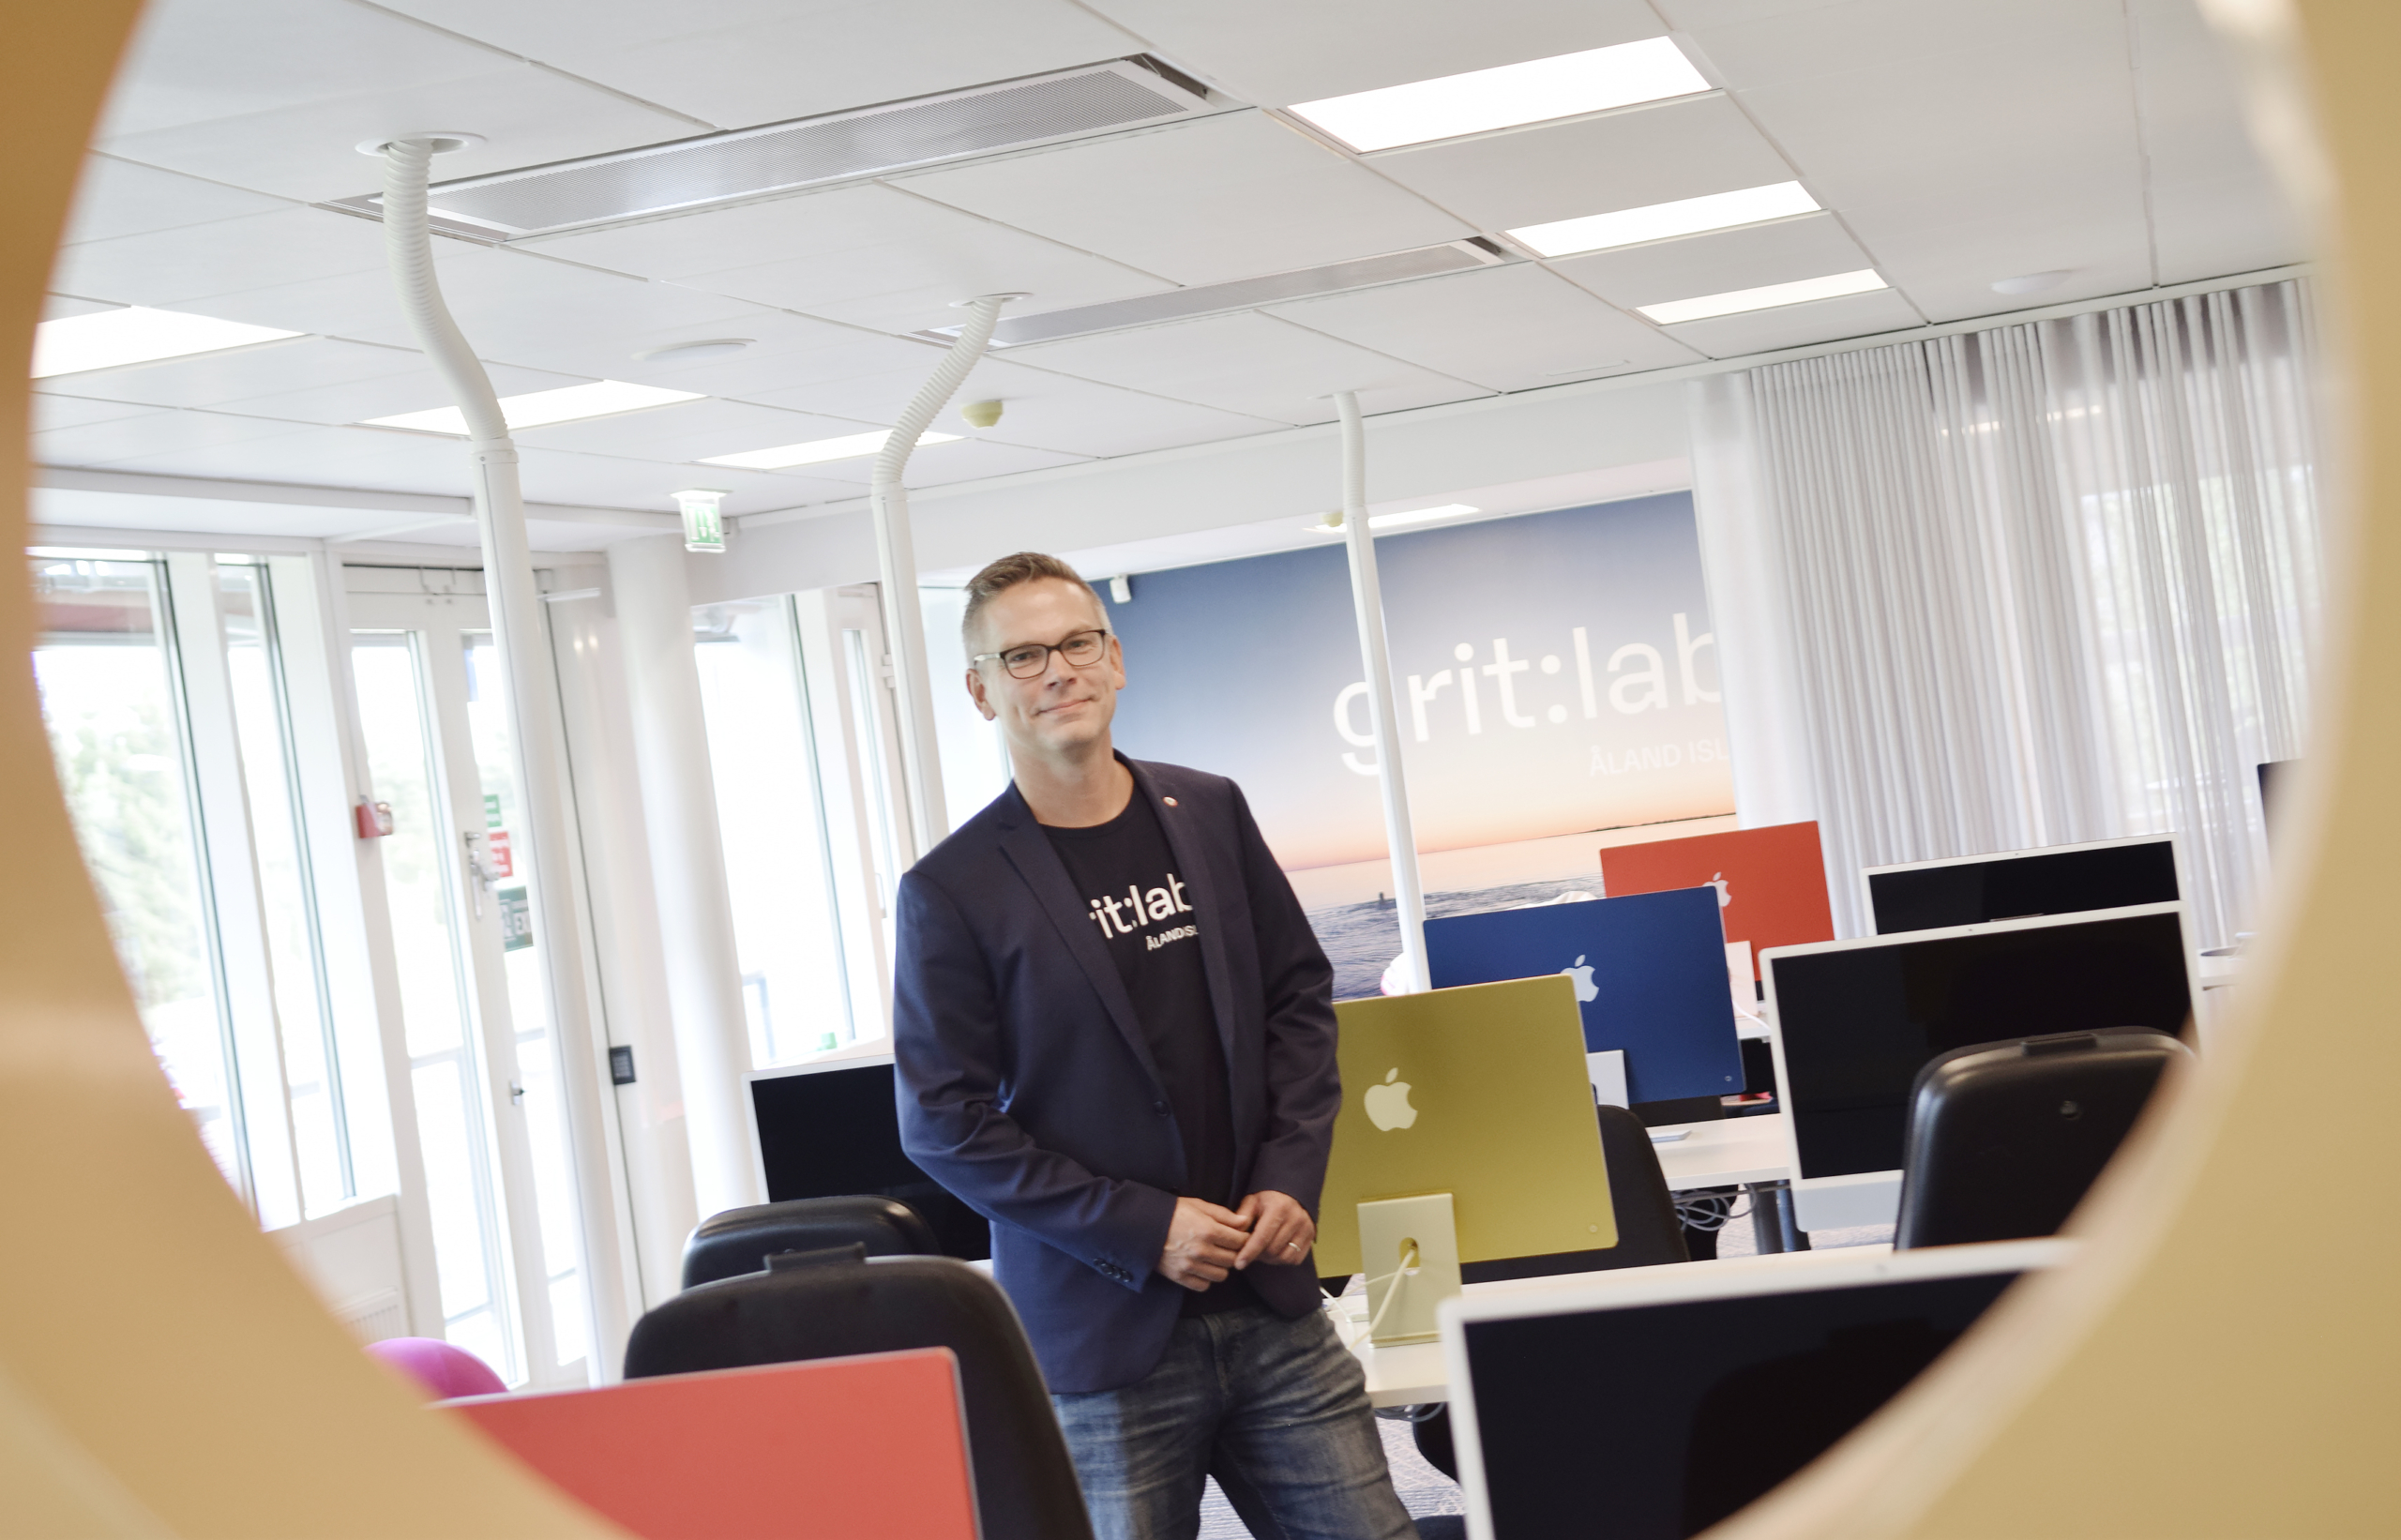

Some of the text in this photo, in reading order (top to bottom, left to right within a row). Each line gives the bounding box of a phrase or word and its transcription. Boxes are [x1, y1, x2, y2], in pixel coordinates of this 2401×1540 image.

[1333, 612, 1722, 776] grit:lab
[1589, 744, 1682, 778] ÅLAND
[1089, 873, 1193, 939] it:lab
